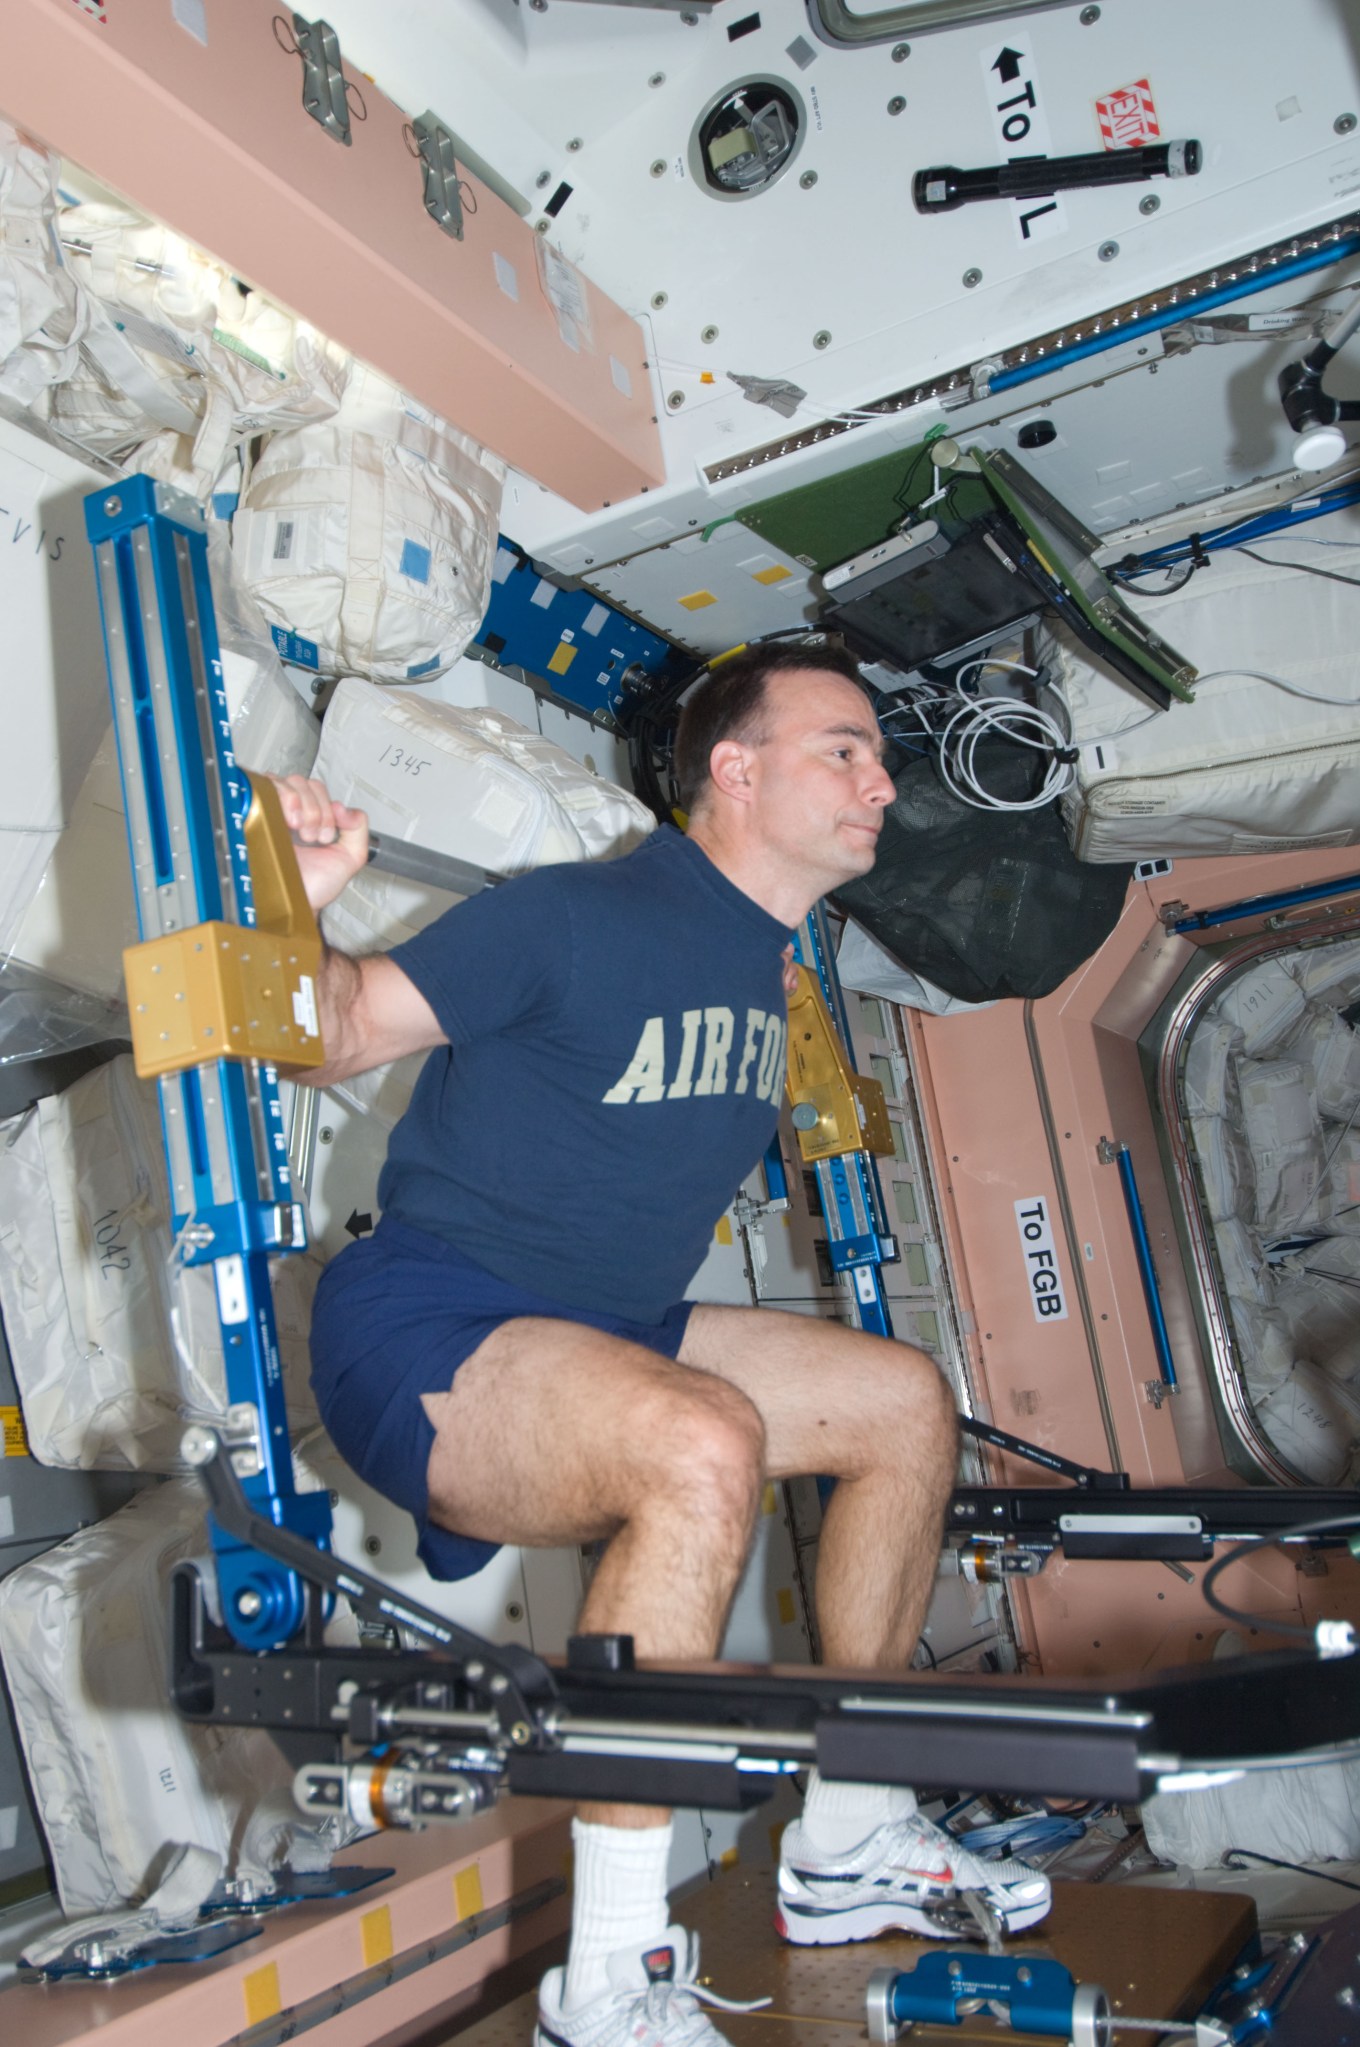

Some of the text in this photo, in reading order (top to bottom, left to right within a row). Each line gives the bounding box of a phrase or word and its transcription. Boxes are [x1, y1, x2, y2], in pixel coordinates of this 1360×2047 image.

[997, 80, 1036, 142] To
[1110, 93, 1144, 147] EXIT
[0, 507, 65, 561] VIS
[379, 744, 432, 776] 1345
[1242, 983, 1274, 1014] 1911
[601, 1006, 735, 1104] AIR
[93, 1209, 131, 1280] 1042
[1020, 1202, 1062, 1317] To FGB
